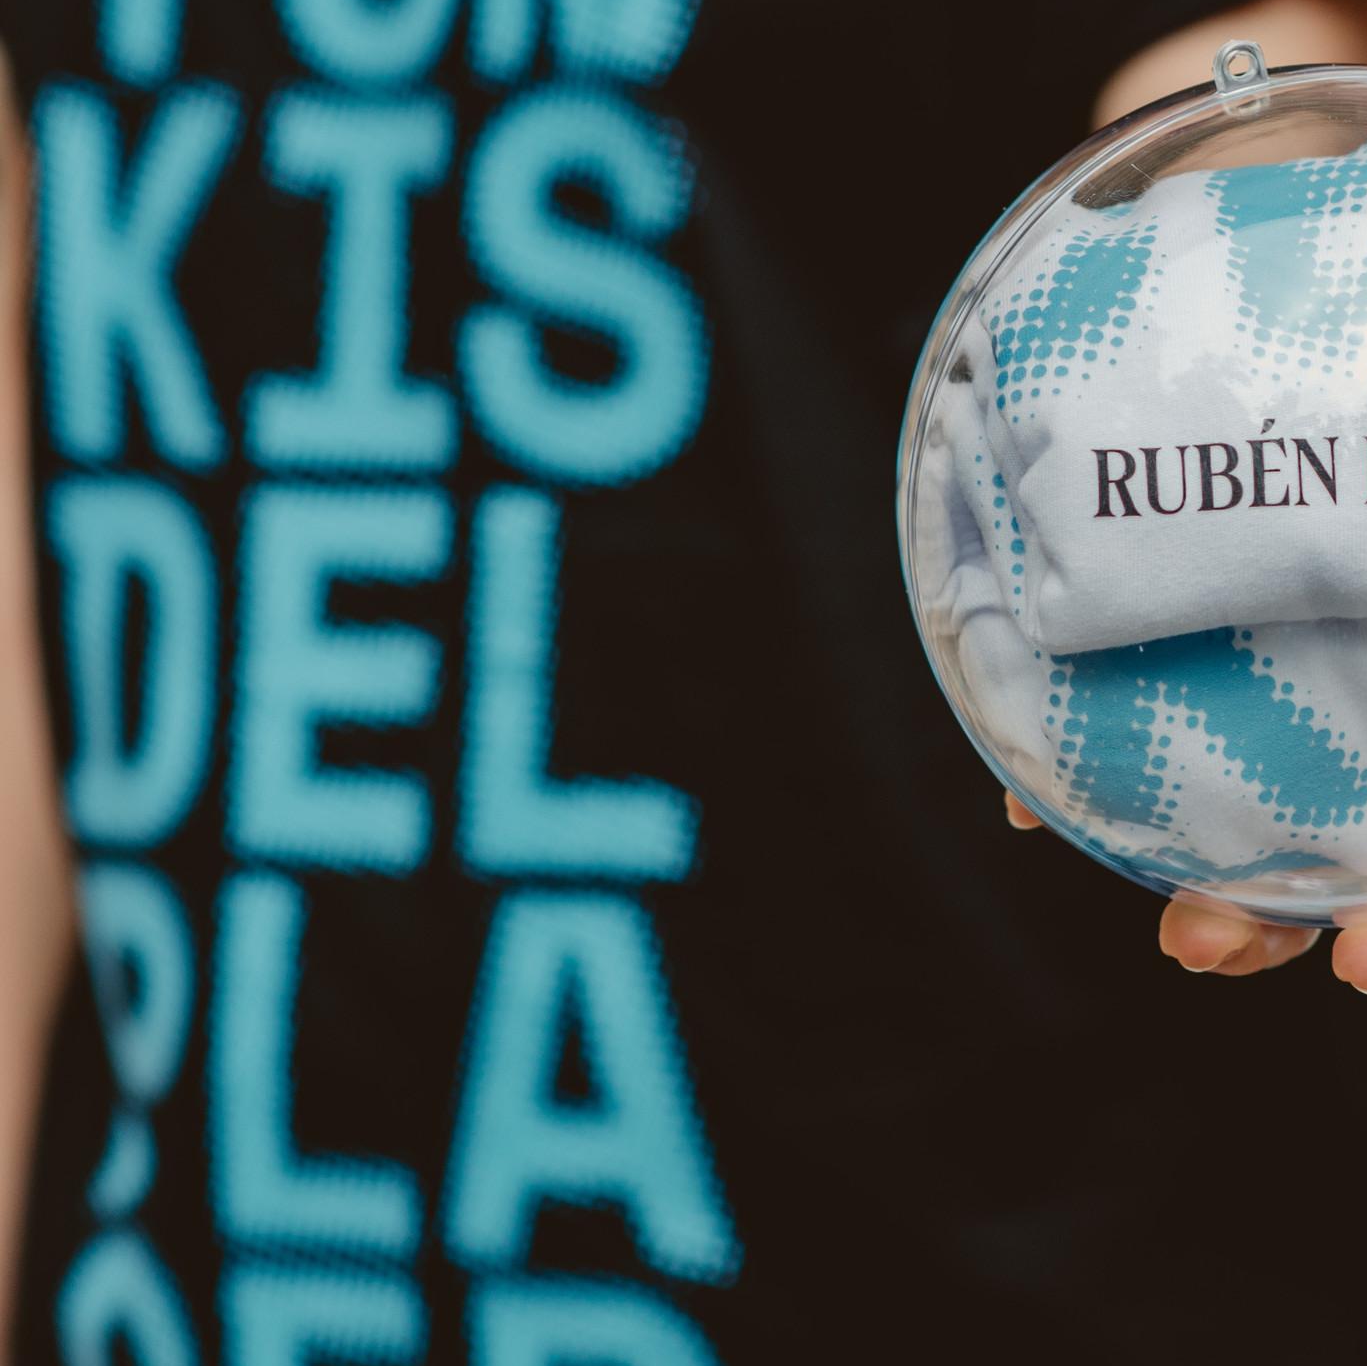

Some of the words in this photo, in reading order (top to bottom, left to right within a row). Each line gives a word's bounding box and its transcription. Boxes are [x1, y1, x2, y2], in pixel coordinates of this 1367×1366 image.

[33, 75, 710, 488] KIS
[1092, 419, 1341, 518] RUBÉN
[46, 469, 702, 883] DEL
